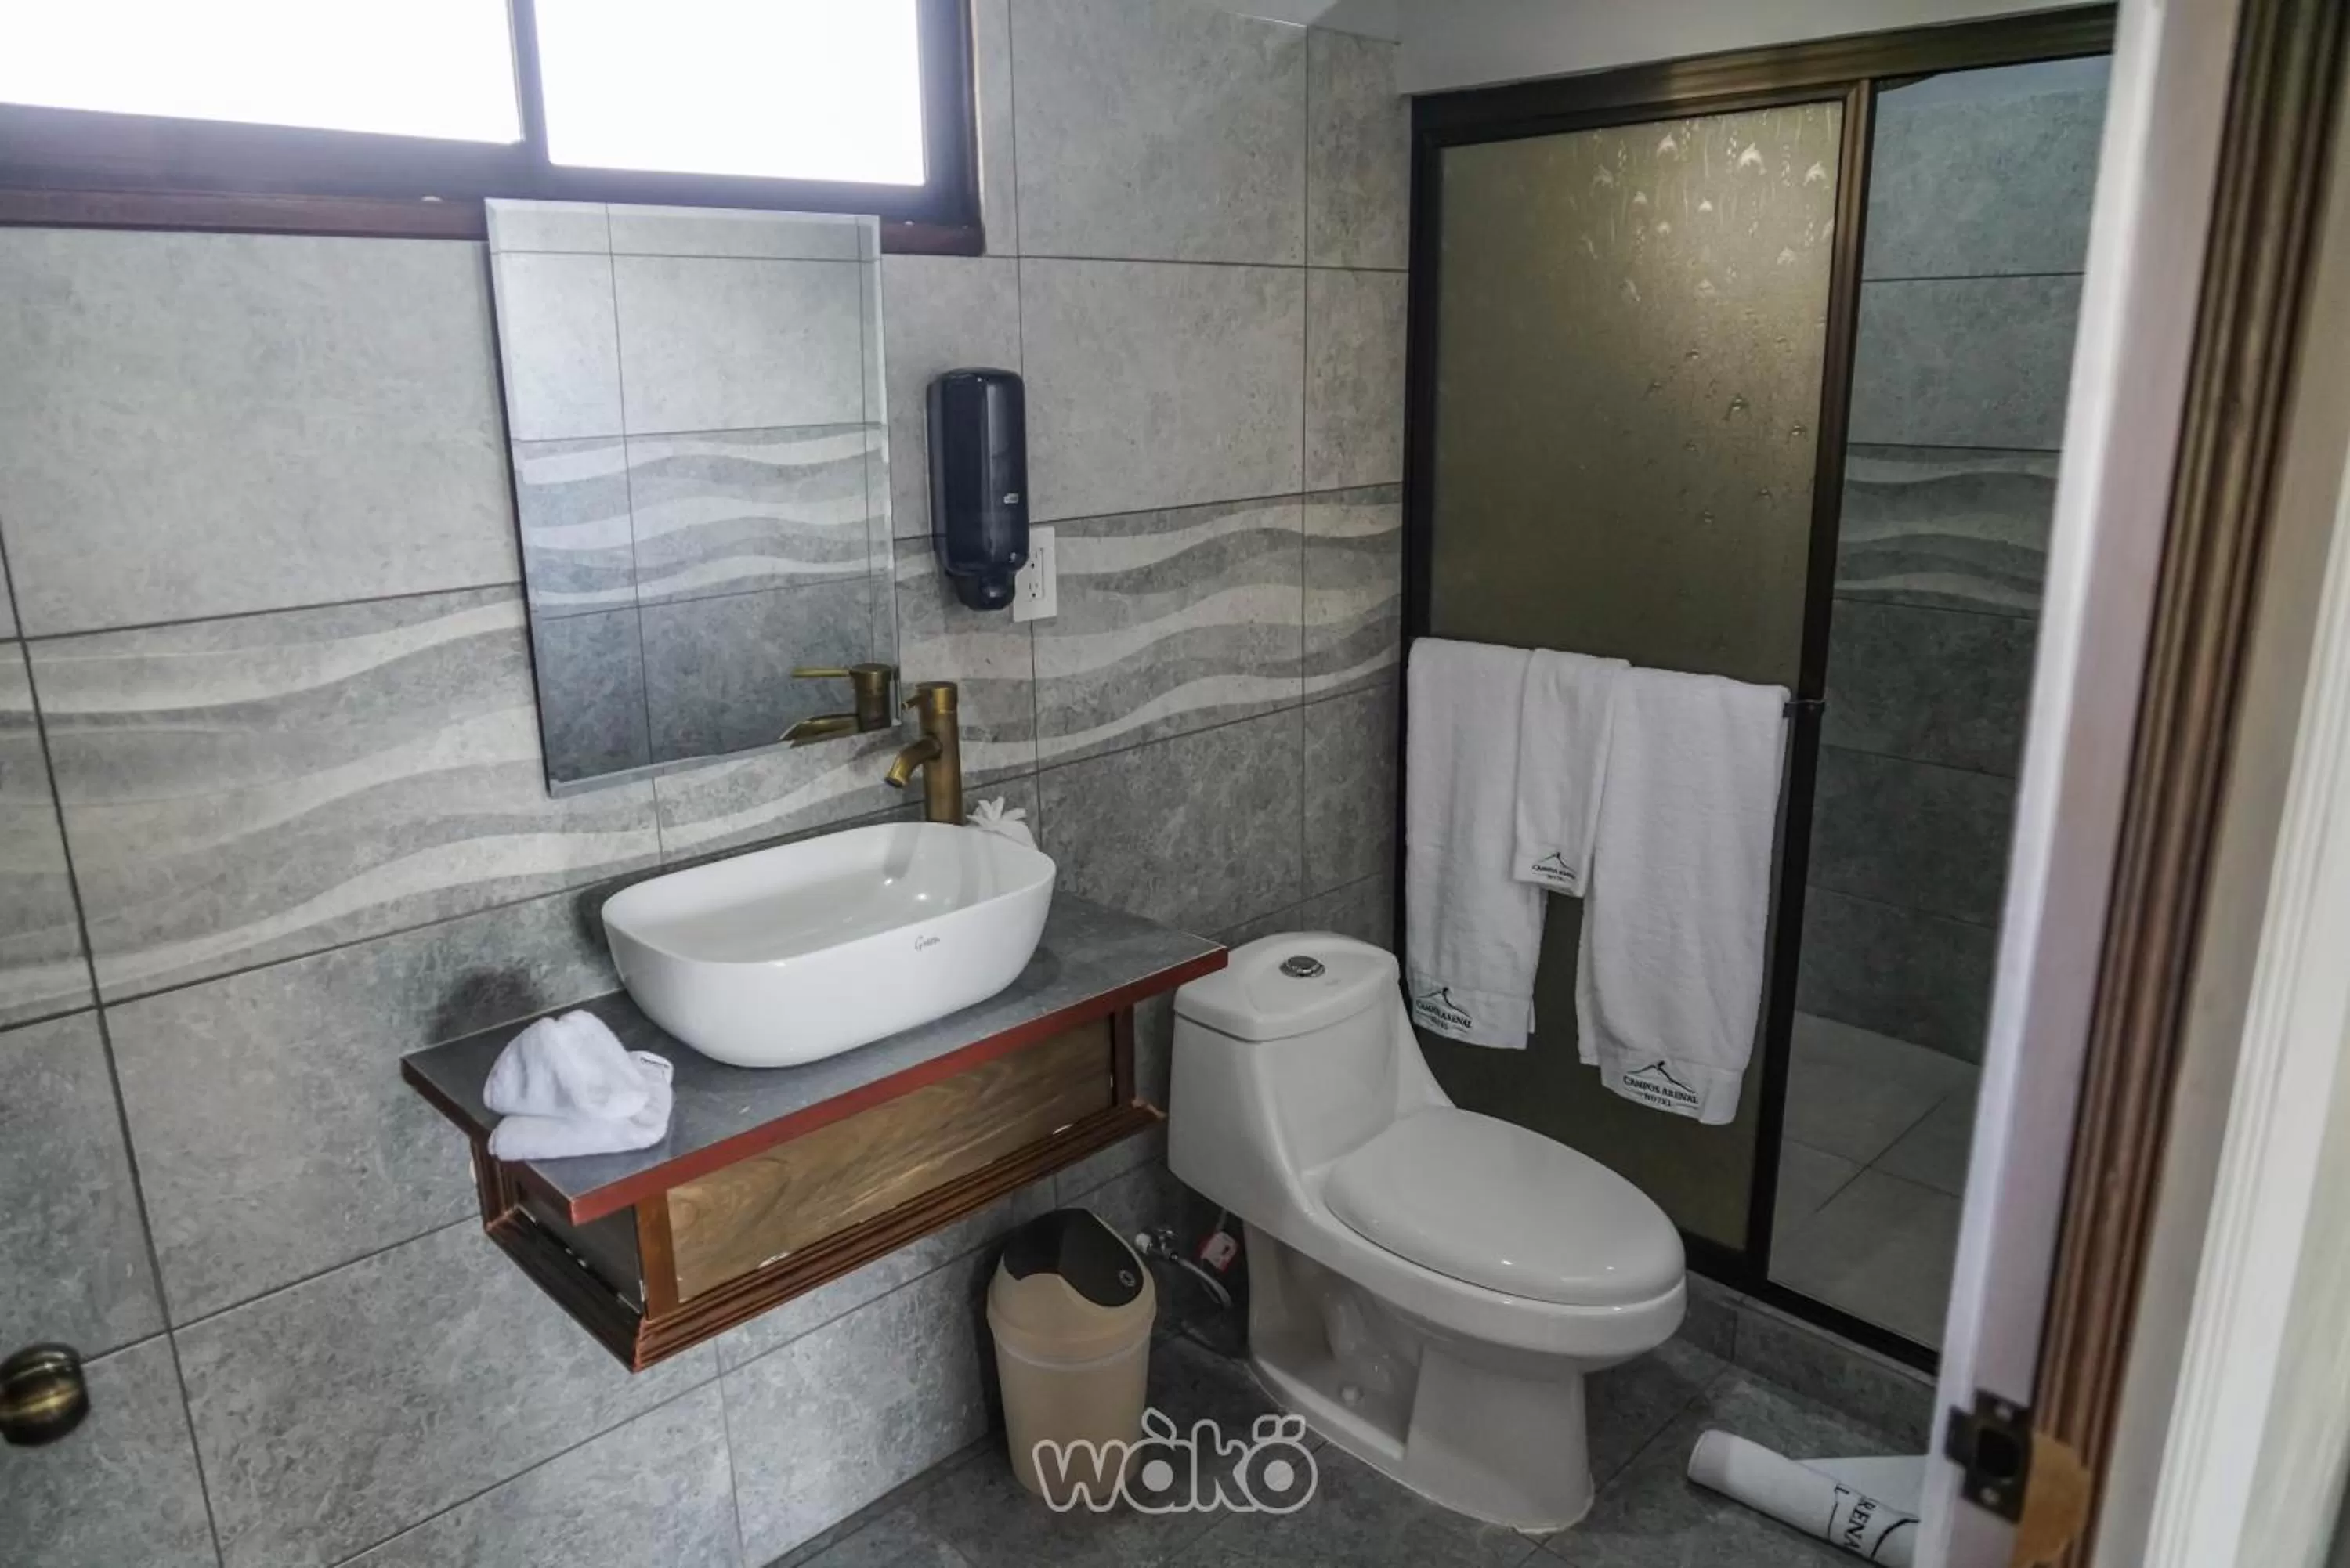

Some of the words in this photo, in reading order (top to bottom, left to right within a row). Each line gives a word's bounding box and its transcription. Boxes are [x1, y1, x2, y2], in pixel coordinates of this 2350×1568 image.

[1623, 1075, 1660, 1093] CAMPOS
[1662, 1086, 1698, 1104] ARENAL
[1843, 1496, 1877, 1549] RENA
